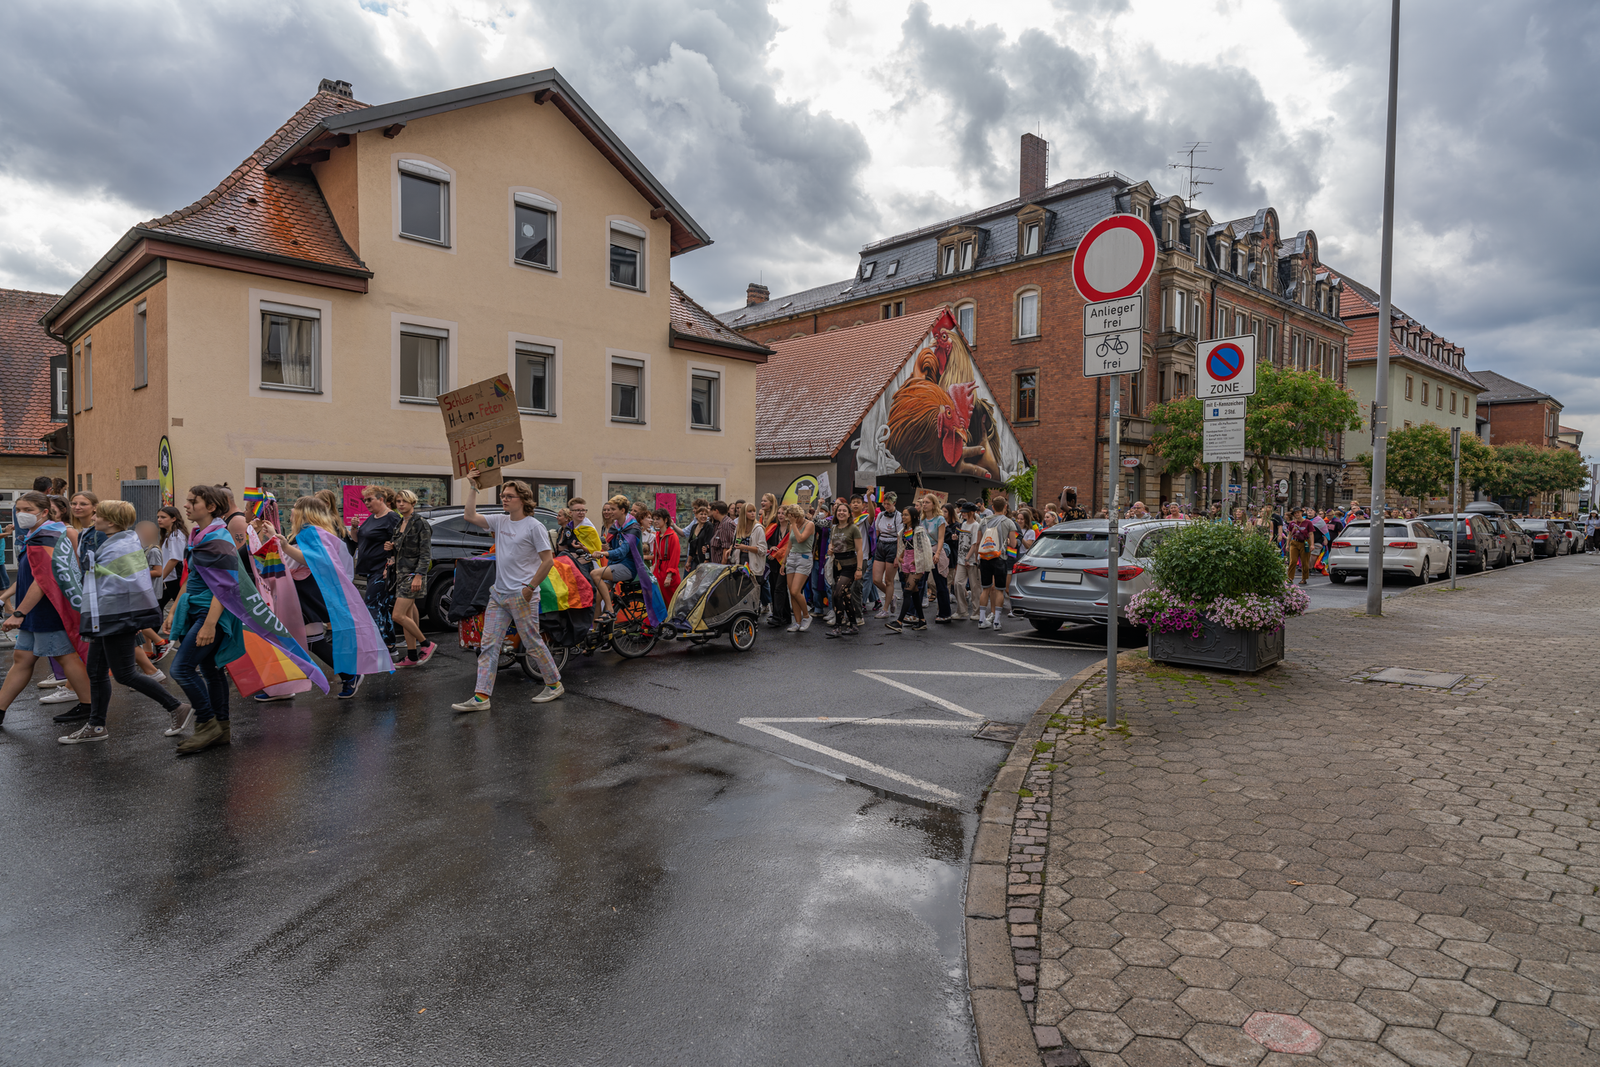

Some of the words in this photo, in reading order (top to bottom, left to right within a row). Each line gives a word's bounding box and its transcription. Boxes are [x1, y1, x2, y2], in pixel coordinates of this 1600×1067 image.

[1090, 304, 1135, 318] Anlieger
[1103, 316, 1122, 329] frei
[1103, 357, 1121, 369] frei
[1210, 382, 1239, 394] ZONE
[443, 392, 474, 411] Schluss
[454, 436, 476, 455] Jetzt
[457, 443, 522, 477] Homo-Promo
